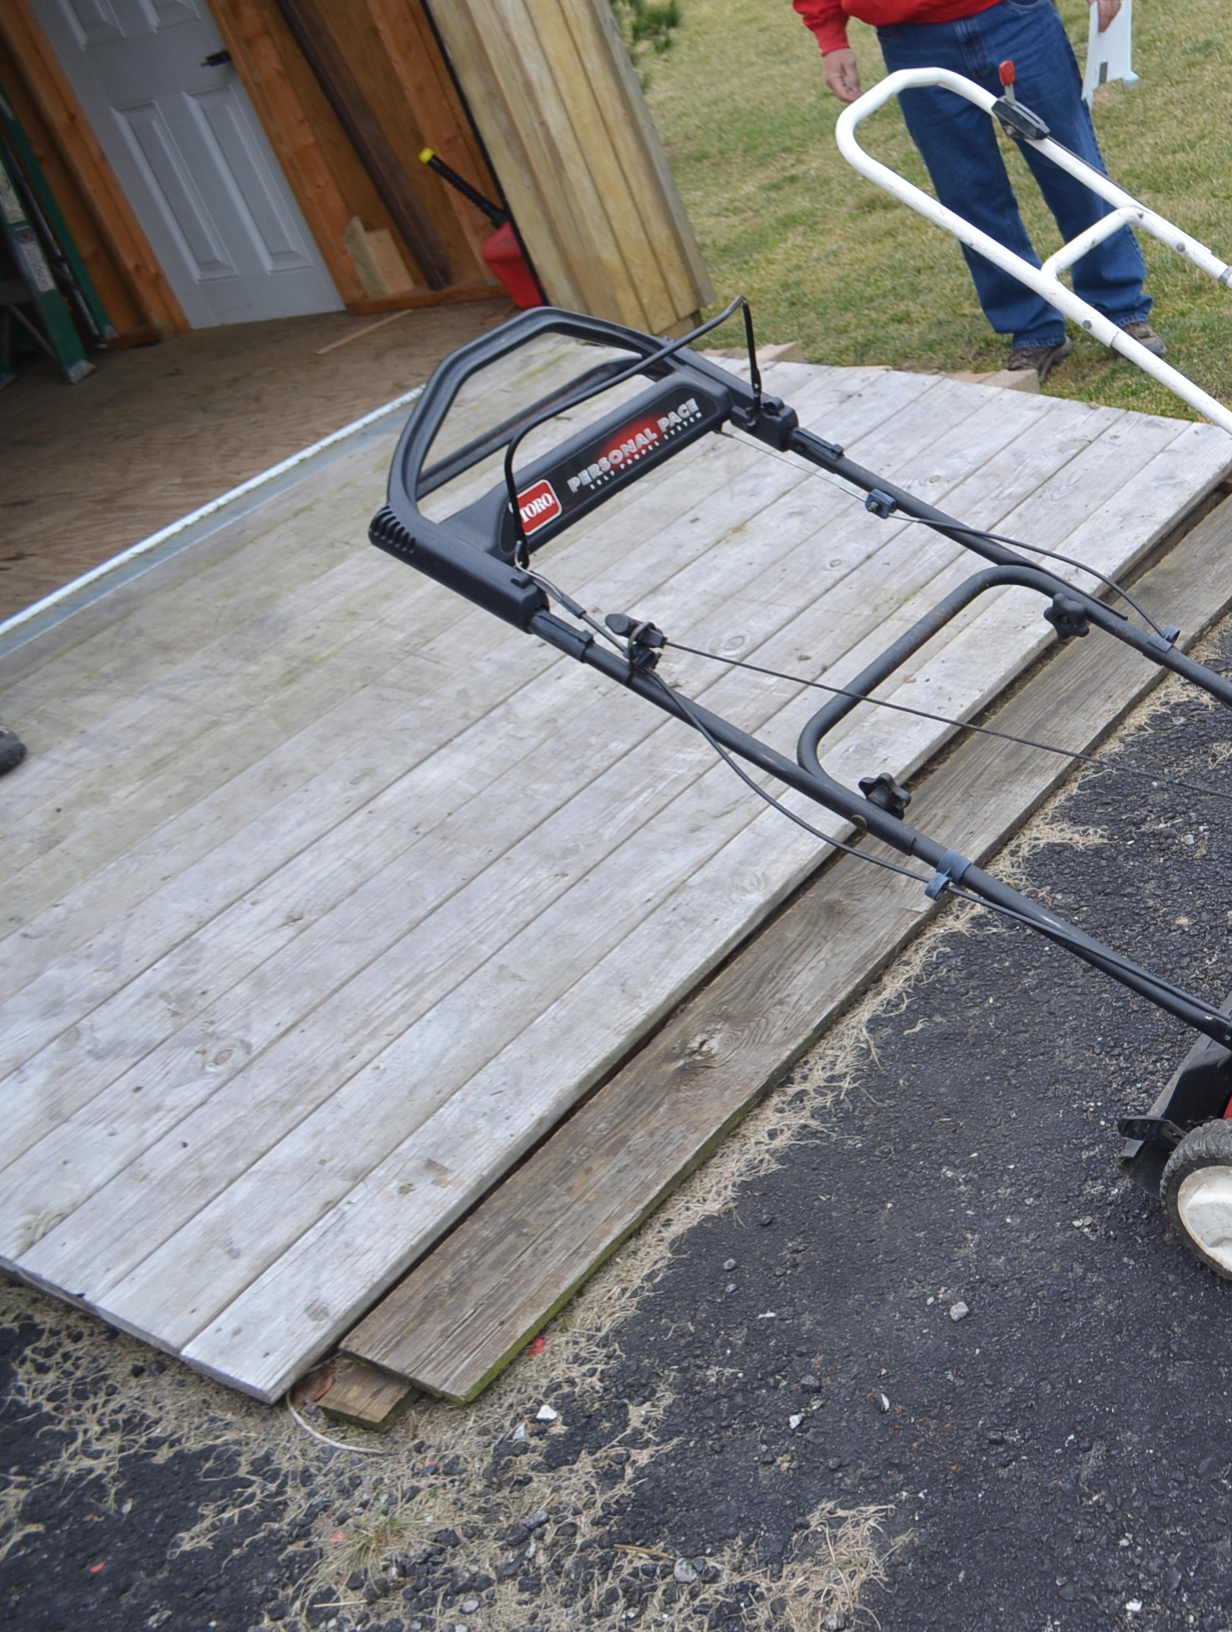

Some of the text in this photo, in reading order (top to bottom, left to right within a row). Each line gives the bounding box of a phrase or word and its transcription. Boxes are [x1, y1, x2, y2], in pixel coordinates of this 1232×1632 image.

[567, 398, 700, 493] PERSONAL PACE
[520, 492, 552, 523] TORO
